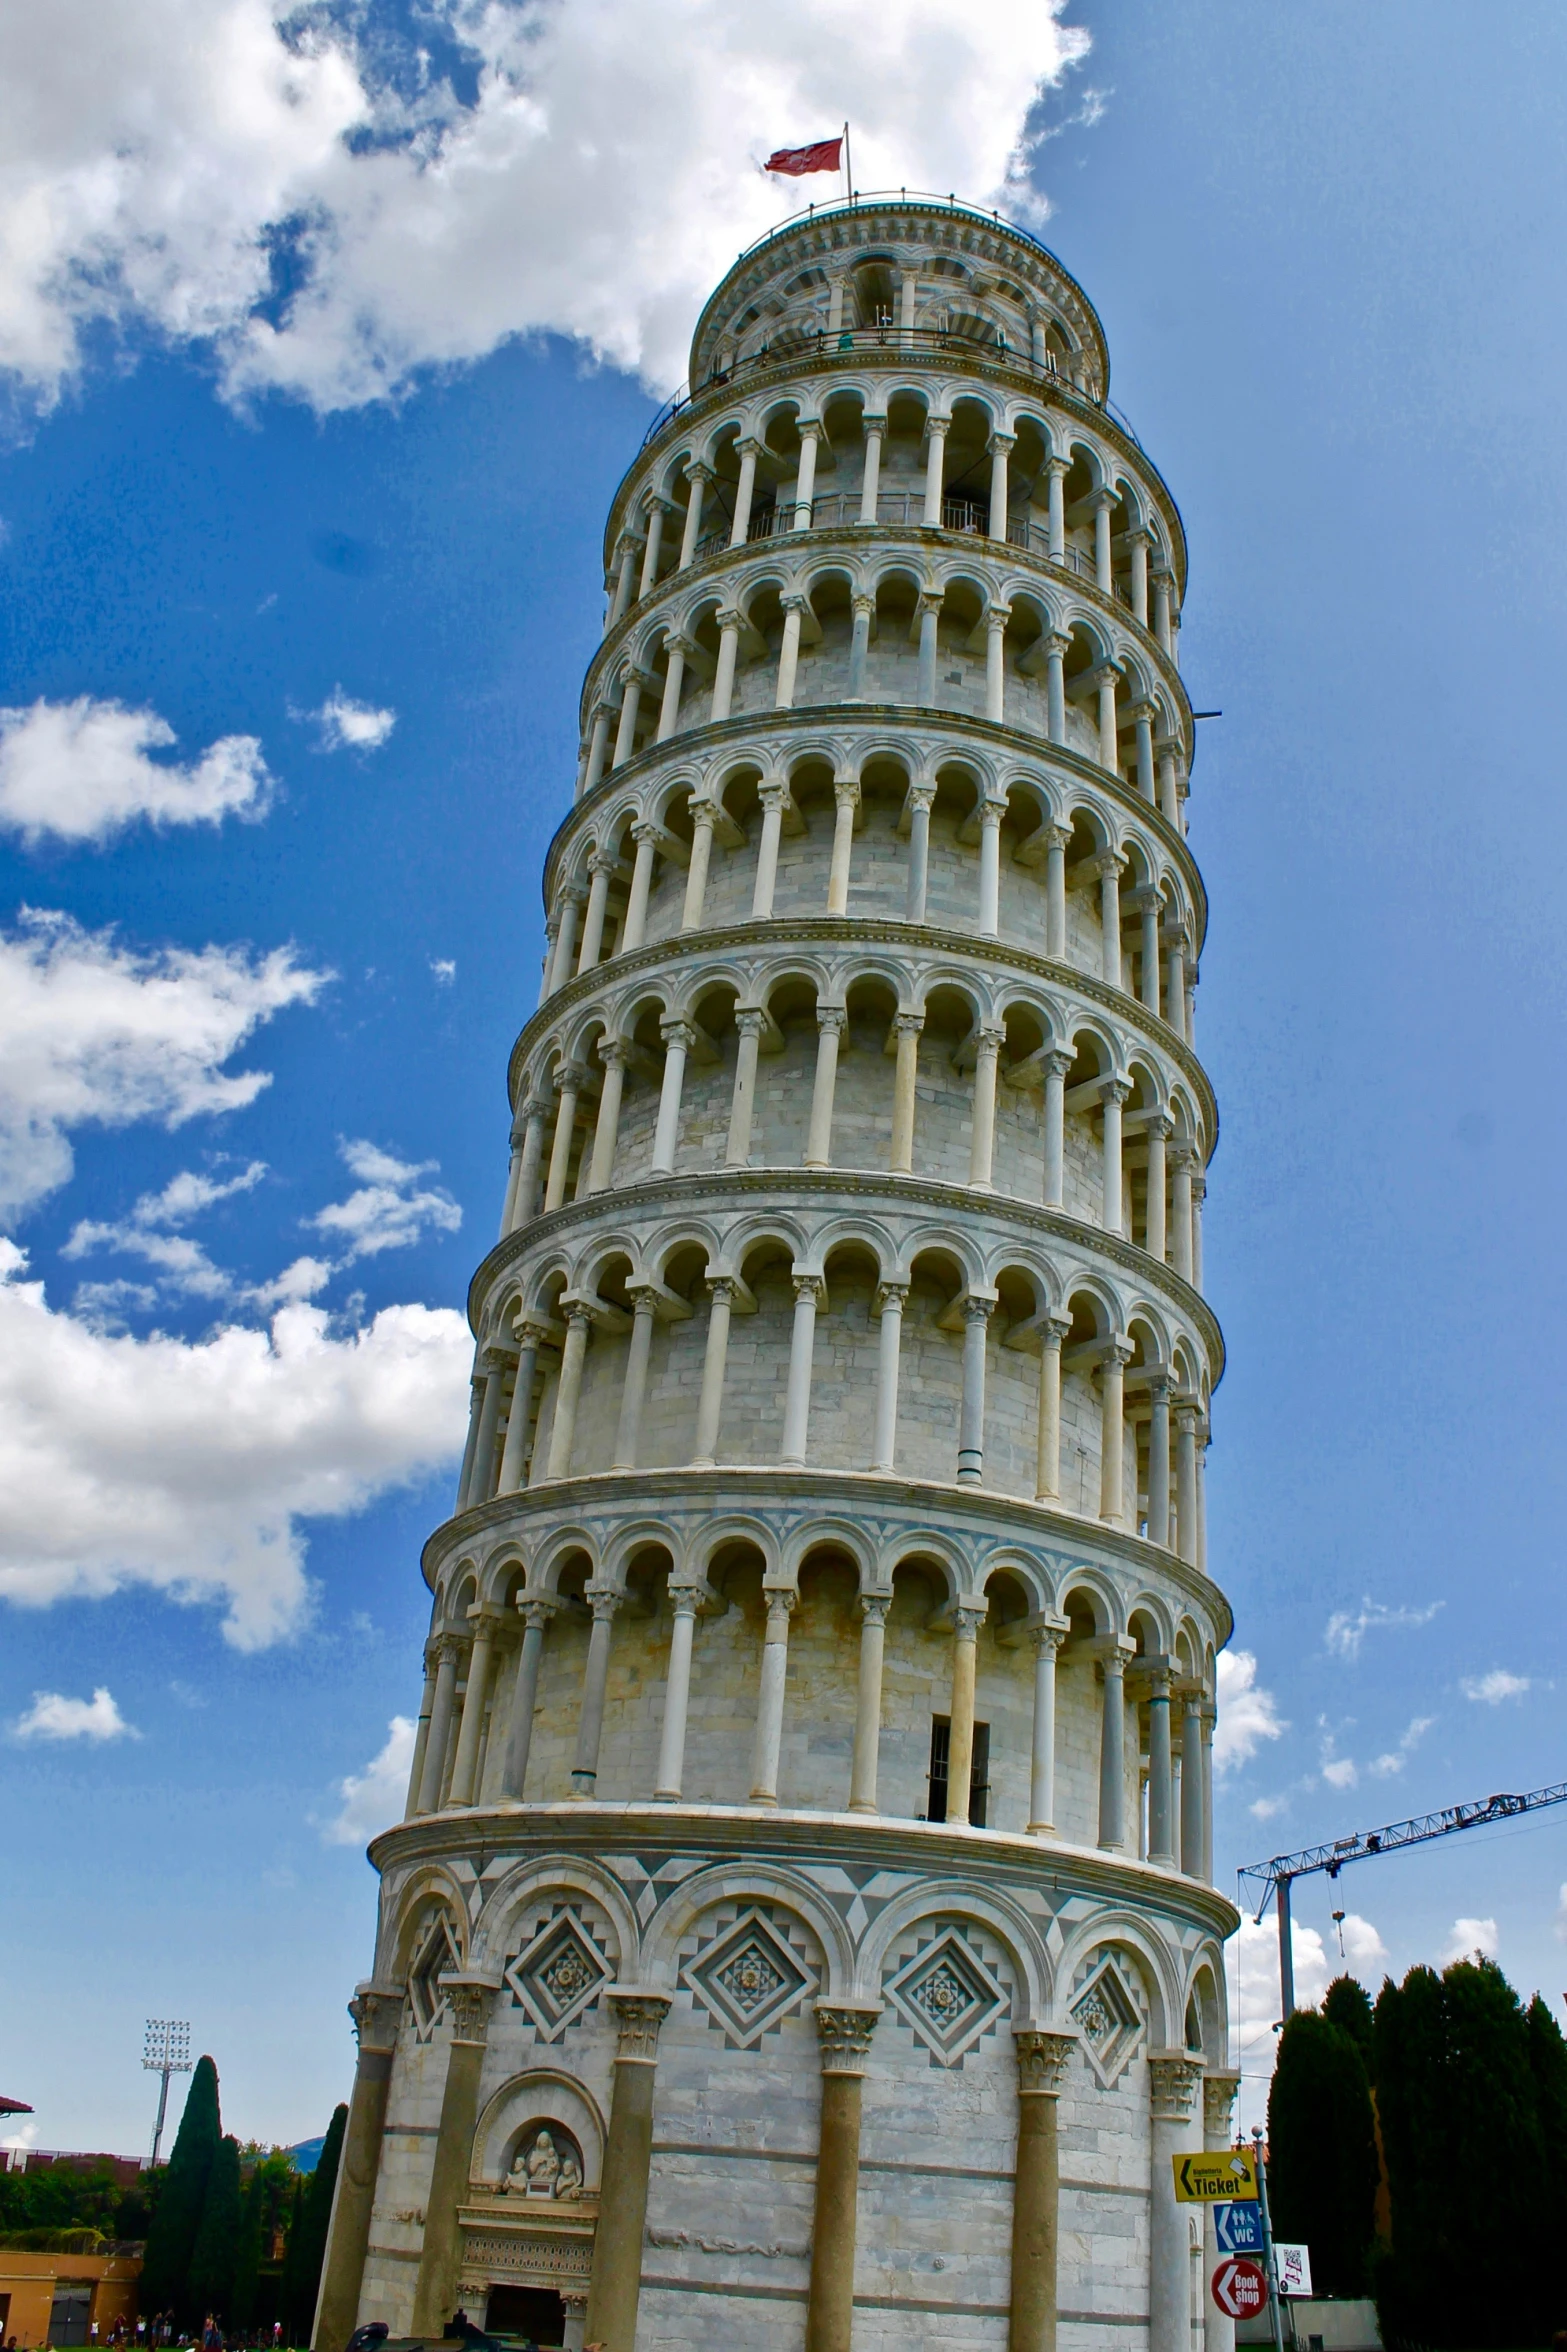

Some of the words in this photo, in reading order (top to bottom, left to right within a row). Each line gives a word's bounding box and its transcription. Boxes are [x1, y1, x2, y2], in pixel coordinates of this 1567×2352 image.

[1194, 2177, 1240, 2195] Ticket
[1234, 2228, 1254, 2243] WC
[1235, 2275, 1258, 2289] Book
[1236, 2289, 1259, 2305] shop
